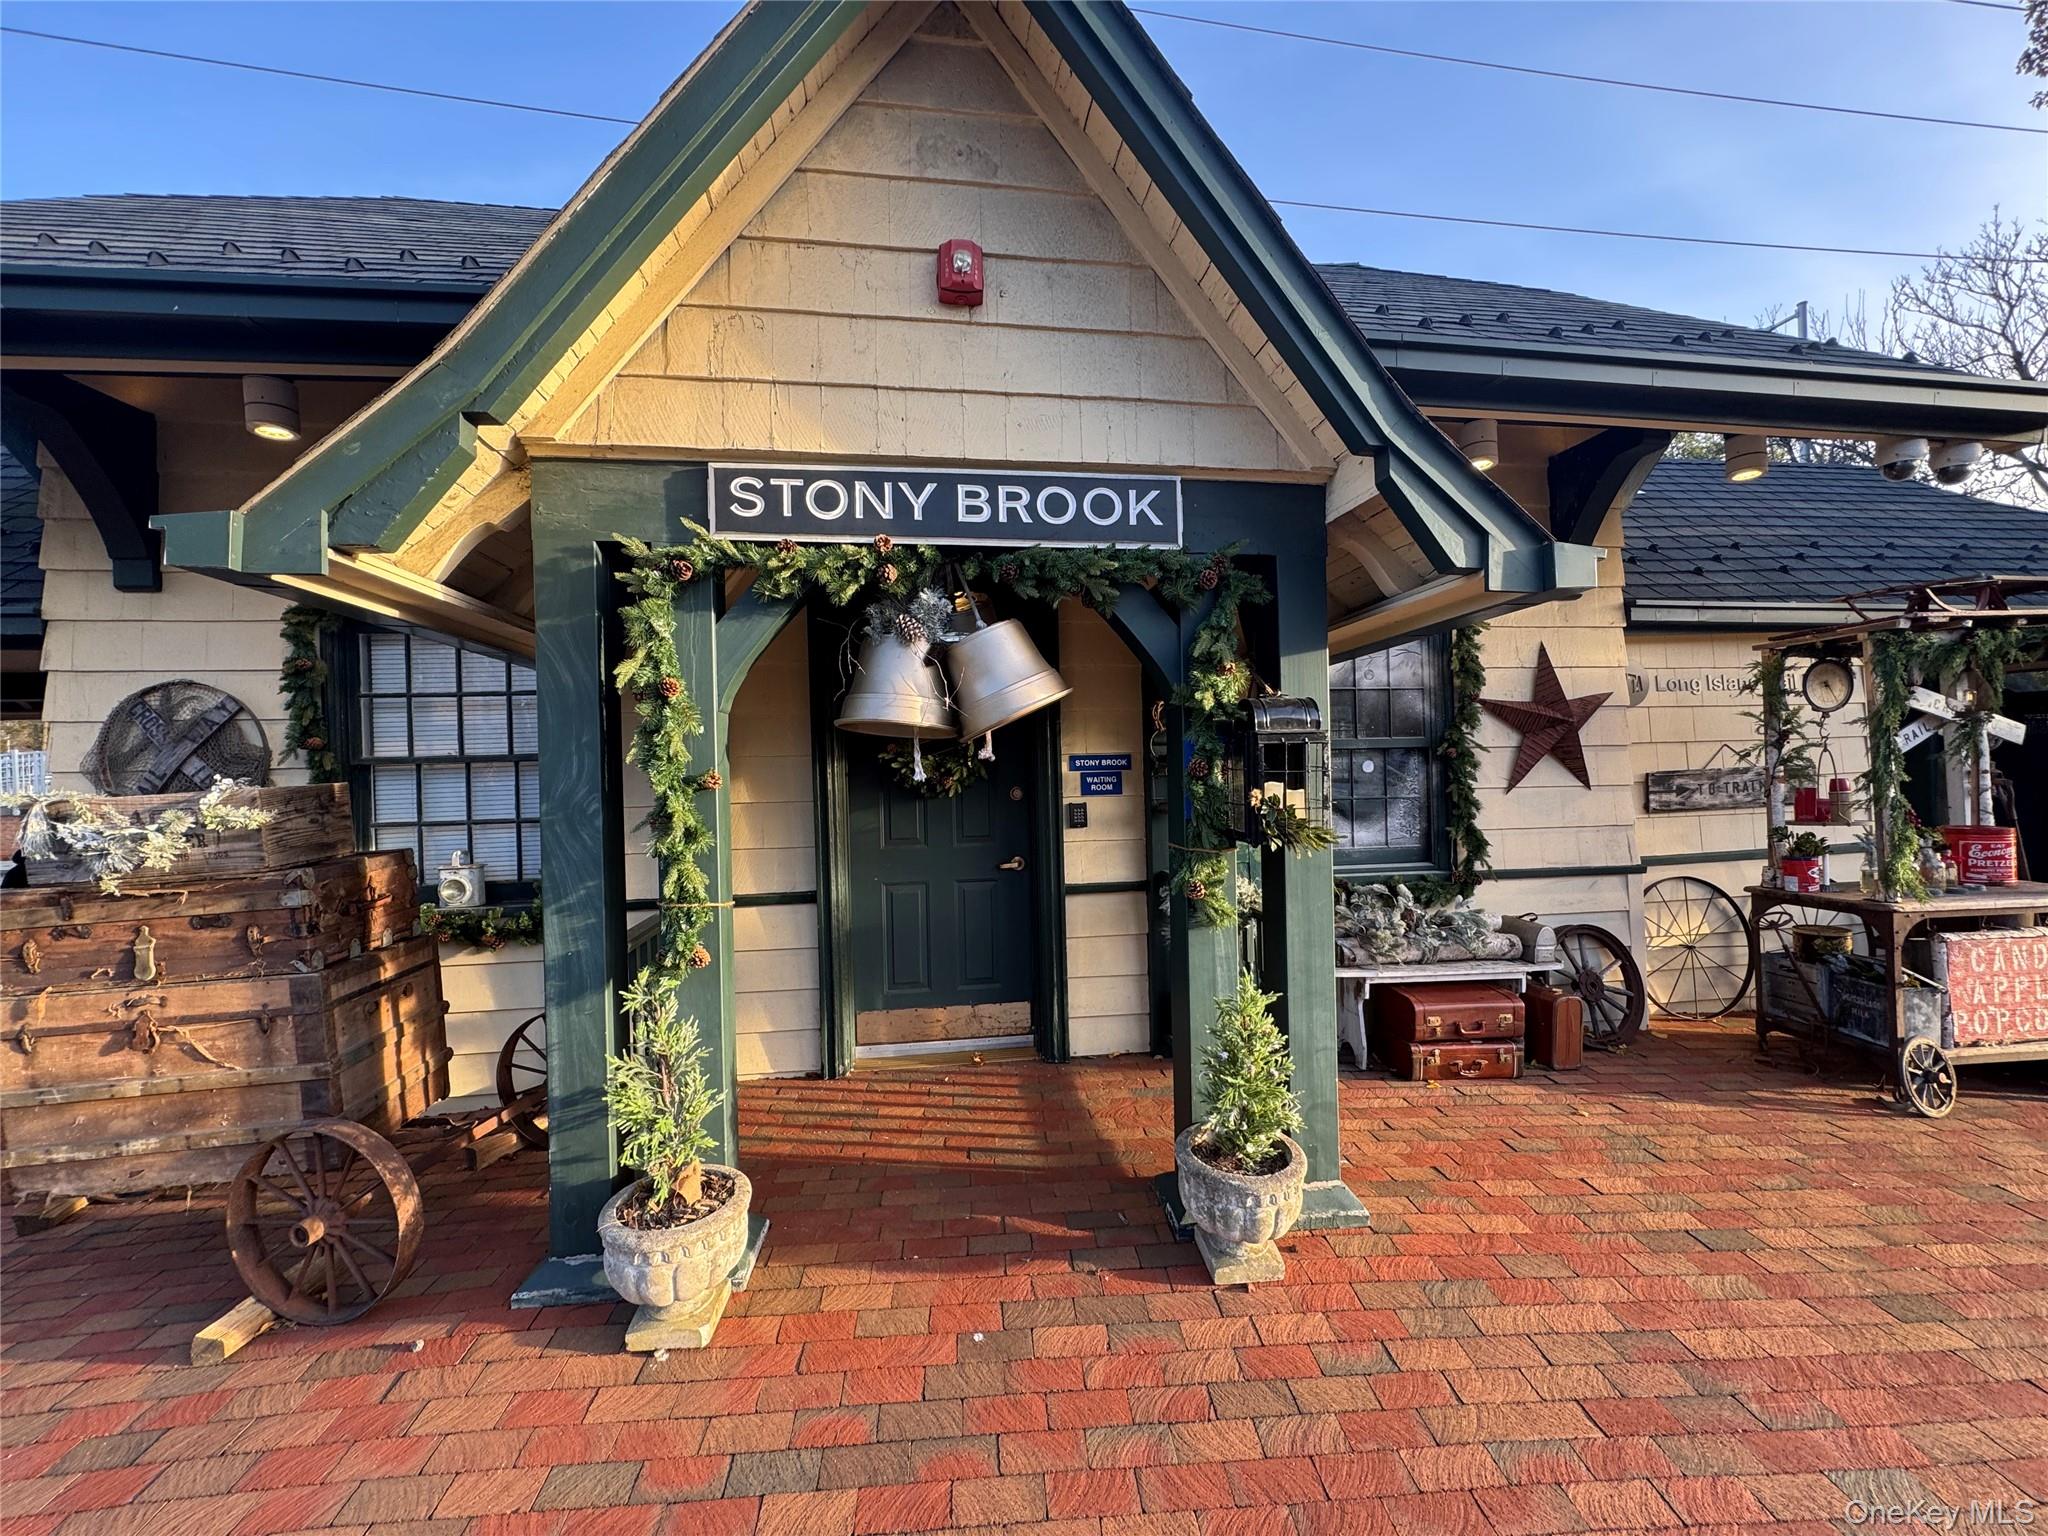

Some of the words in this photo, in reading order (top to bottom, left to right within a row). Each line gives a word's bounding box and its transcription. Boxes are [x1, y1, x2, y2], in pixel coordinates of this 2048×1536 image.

[729, 475, 939, 522] STONY
[956, 483, 1165, 527] BROOK
[1654, 674, 1702, 697] Long
[1705, 674, 1759, 692] Islan
[1902, 721, 1934, 745] RAIL
[1075, 759, 1100, 767] STONY
[1101, 758, 1128, 766] BROOK
[1086, 775, 1117, 783] WAITING
[1697, 782, 1716, 796] TO
